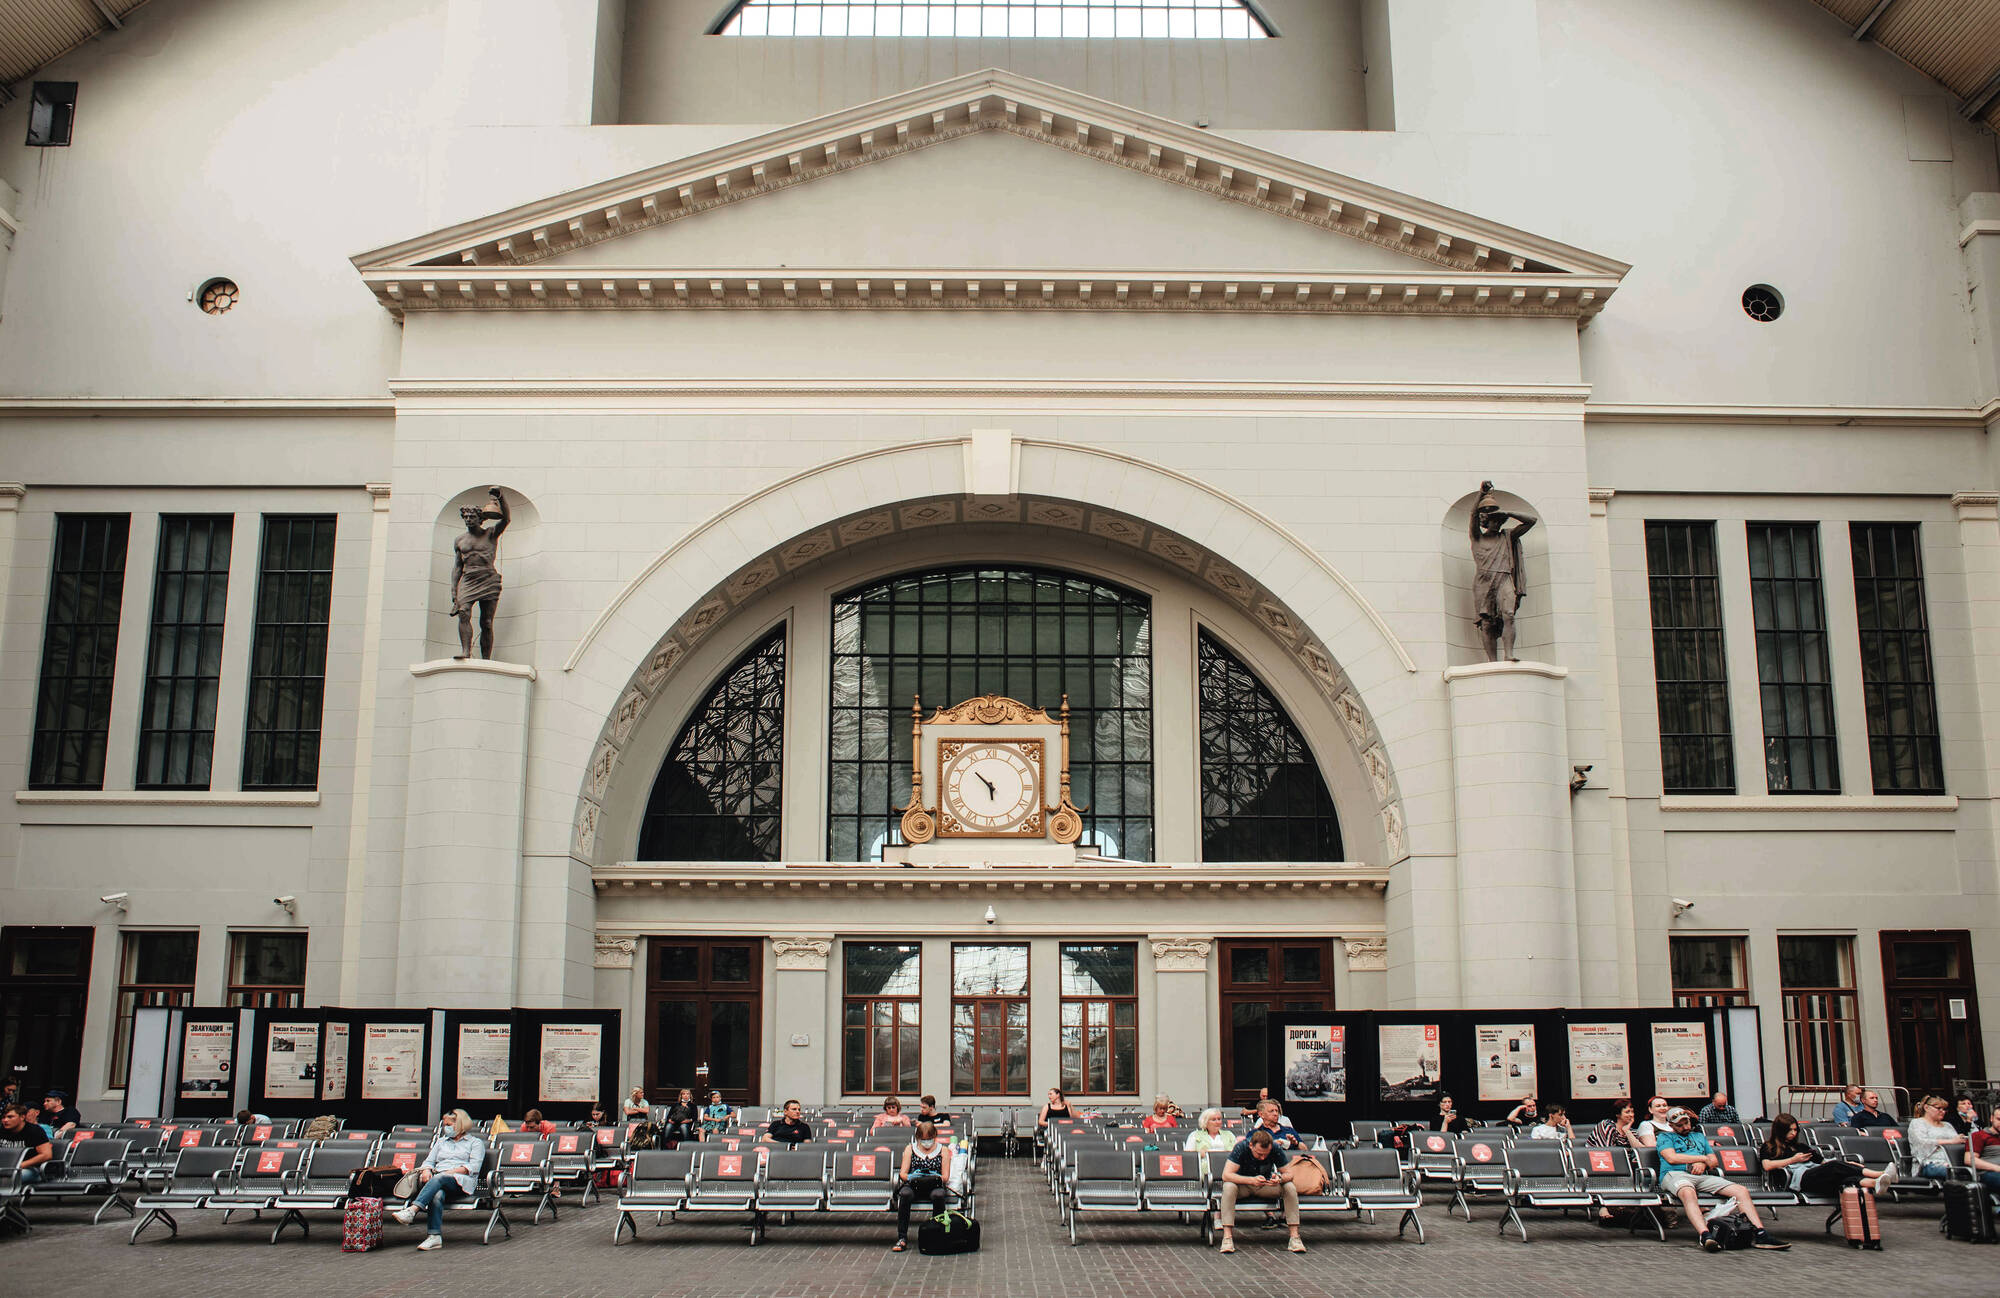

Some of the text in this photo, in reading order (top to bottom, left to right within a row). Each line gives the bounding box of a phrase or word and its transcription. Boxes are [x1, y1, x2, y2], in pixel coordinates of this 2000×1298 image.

[969, 753, 978, 763] XI
[986, 749, 997, 759] XII
[950, 784, 959, 793] IX
[986, 817, 995, 826] VI
[190, 1024, 223, 1032] ЭВАКУАЦИЯ
[1289, 1029, 1317, 1040] ДОРОГИ
[1296, 1040, 1326, 1051] ПОБЕДЫ
